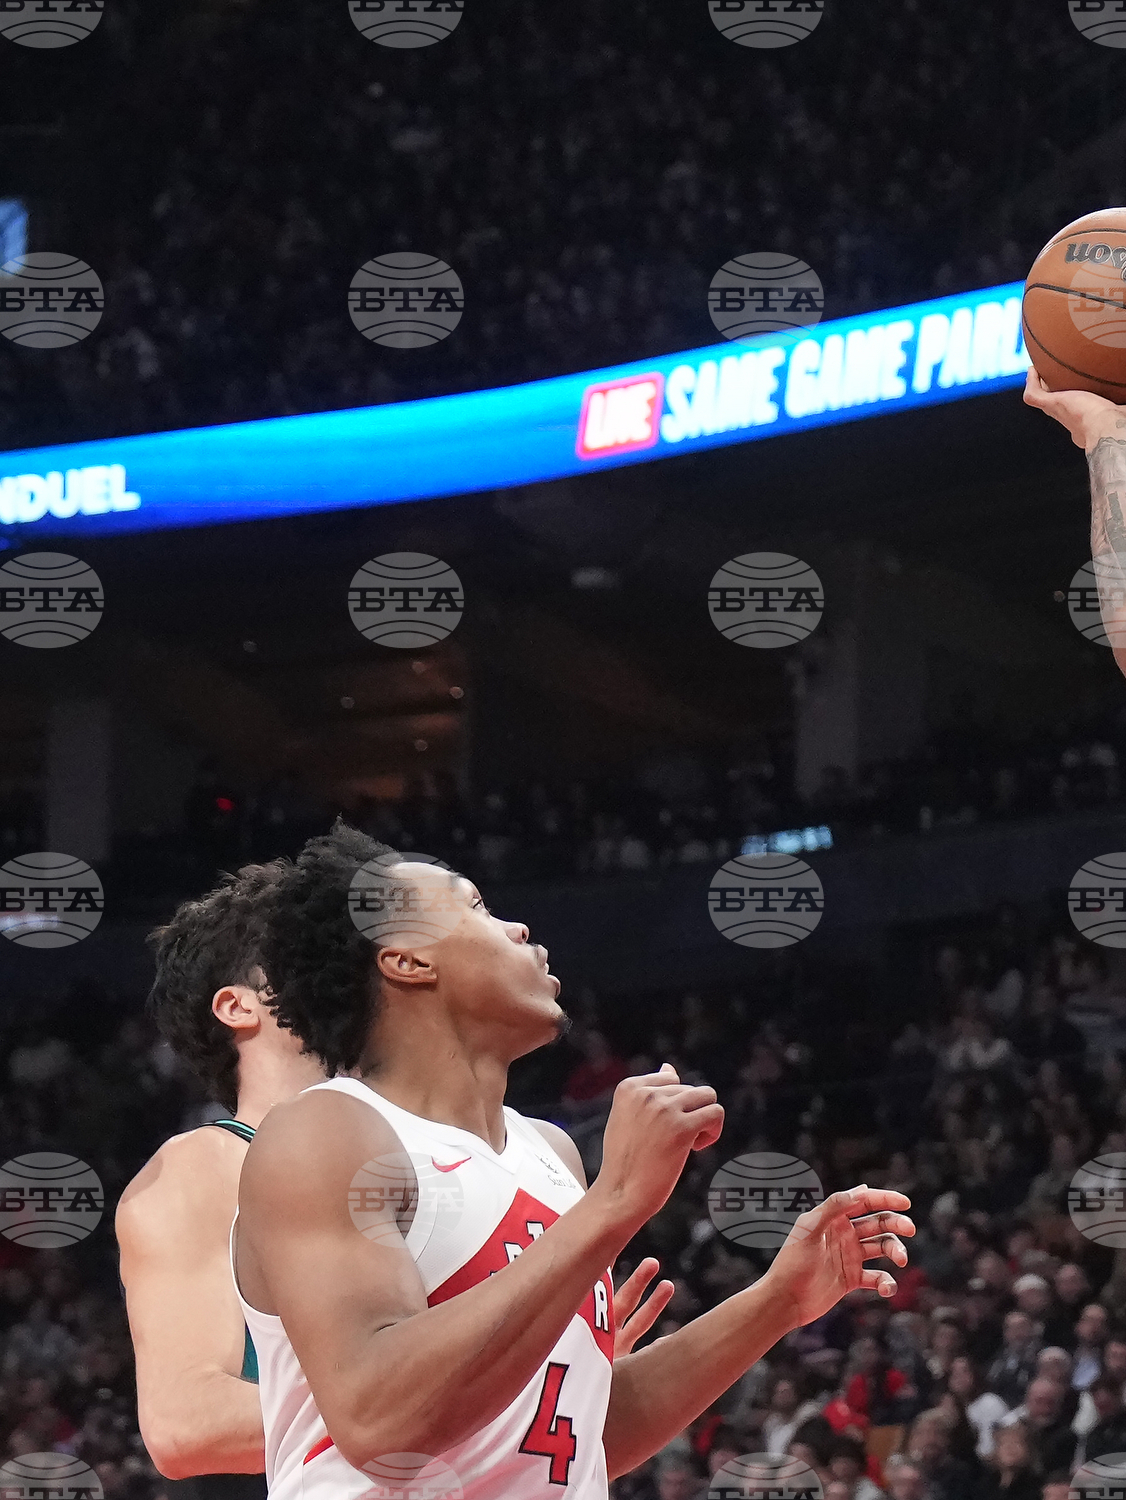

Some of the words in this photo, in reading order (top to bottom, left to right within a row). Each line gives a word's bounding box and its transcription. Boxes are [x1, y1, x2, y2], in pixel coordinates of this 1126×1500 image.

[660, 346, 786, 443] SAME
[784, 319, 915, 419] GAME
[517, 1360, 578, 1487] 4
